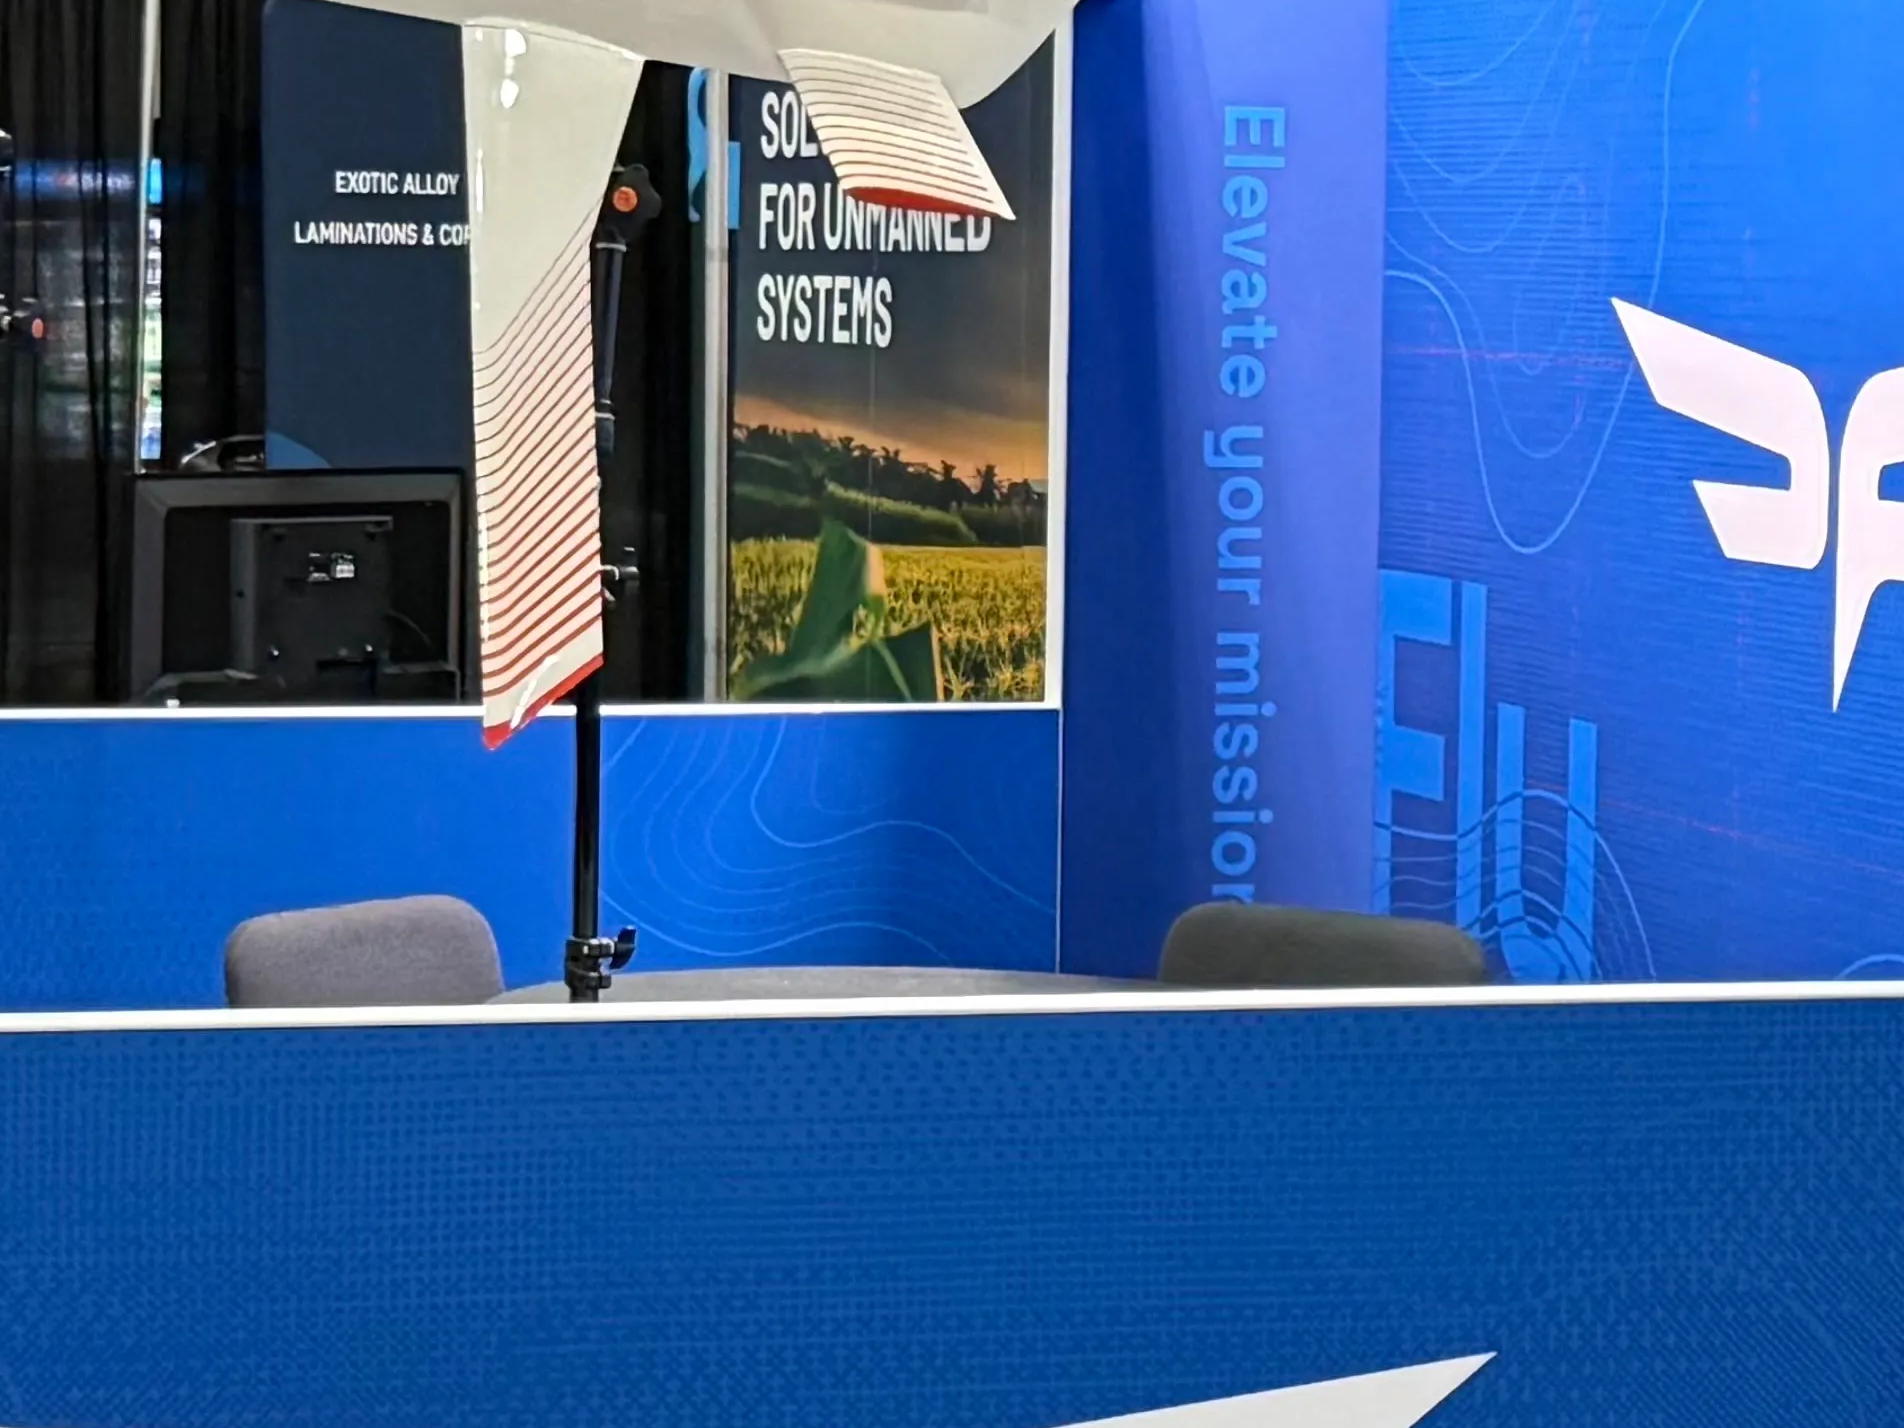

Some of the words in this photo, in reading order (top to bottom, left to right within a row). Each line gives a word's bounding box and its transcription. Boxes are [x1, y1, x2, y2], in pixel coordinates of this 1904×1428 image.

[334, 170, 399, 195] EXOTIC
[402, 172, 460, 196] ALLOY
[758, 182, 817, 252] FOR
[822, 182, 993, 253] UNMANNED
[294, 220, 418, 246] LAMINATIONS
[421, 223, 435, 246] &
[1219, 104, 1287, 400] Elevate
[756, 273, 893, 349] SYSTEMS
[1203, 424, 1266, 606] your
